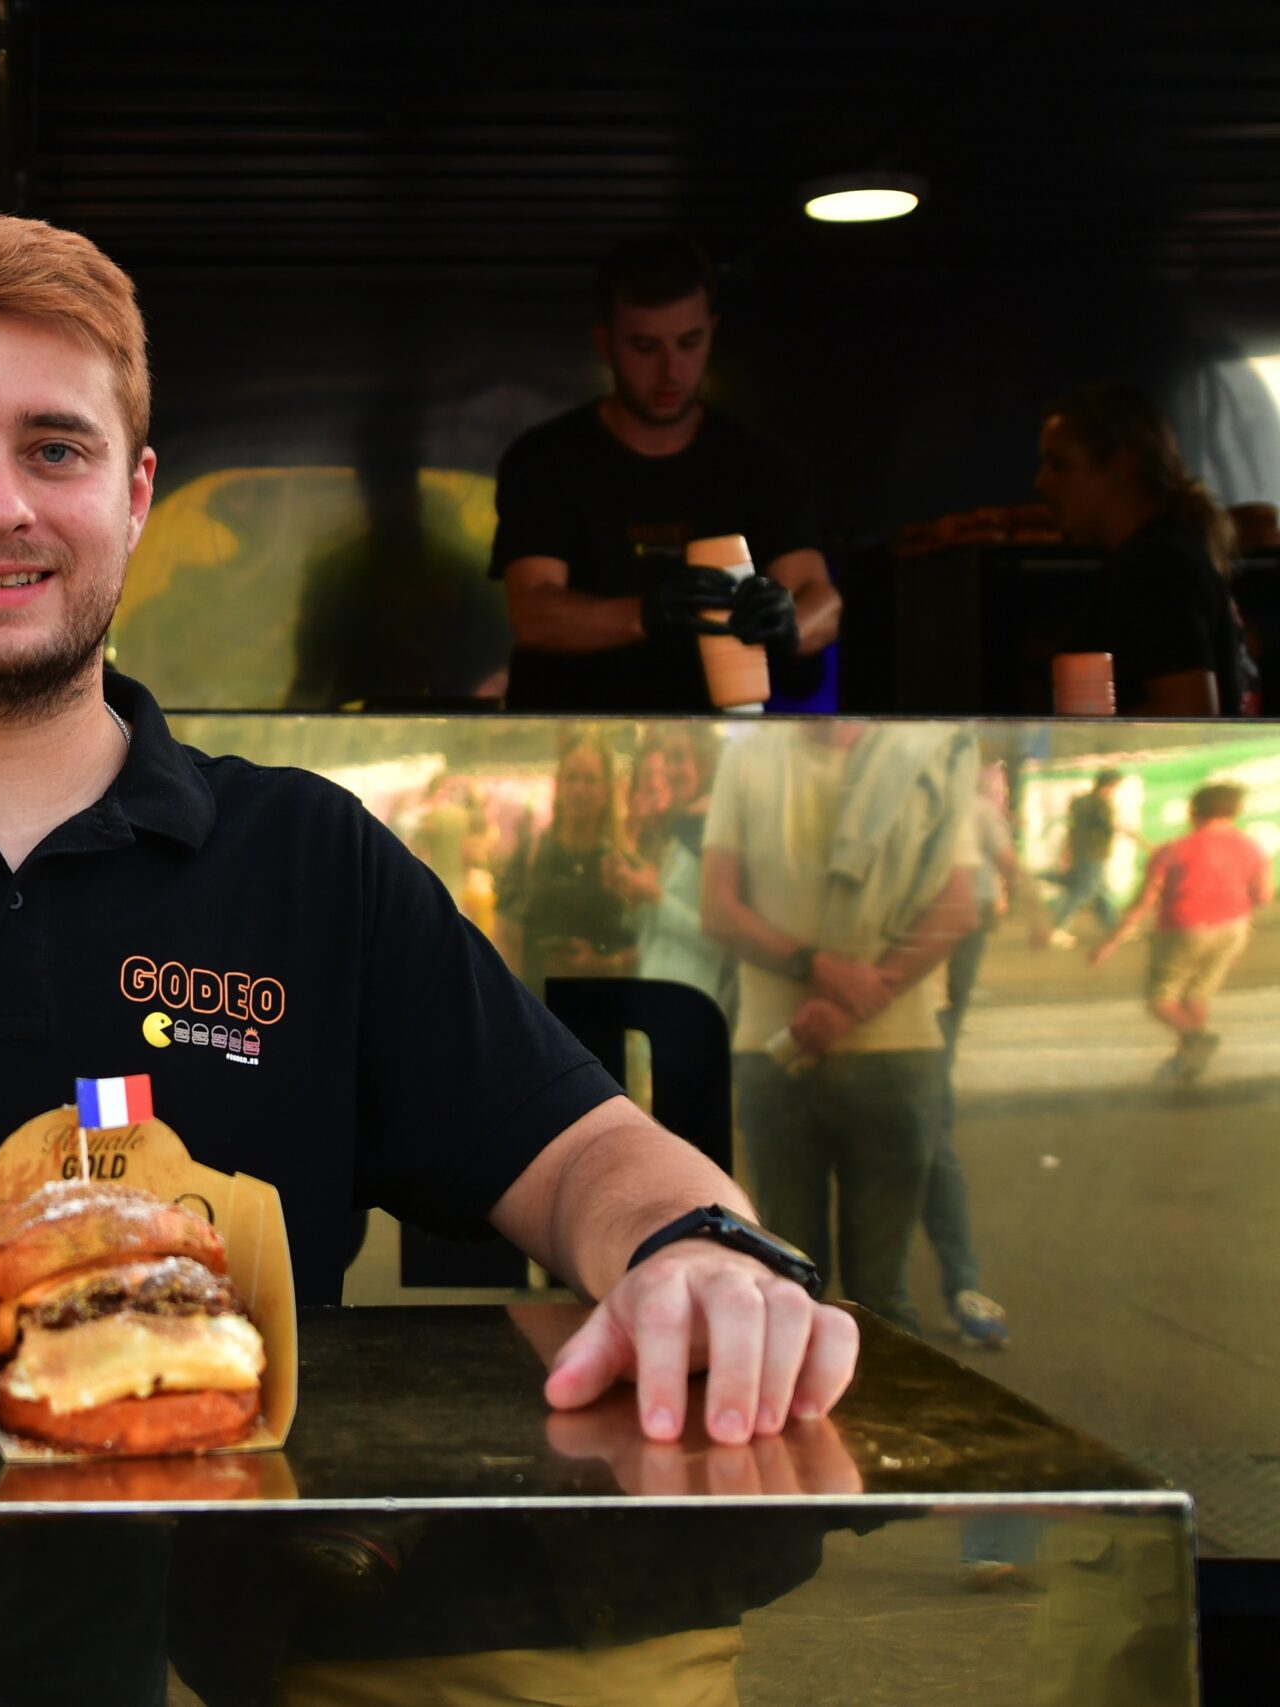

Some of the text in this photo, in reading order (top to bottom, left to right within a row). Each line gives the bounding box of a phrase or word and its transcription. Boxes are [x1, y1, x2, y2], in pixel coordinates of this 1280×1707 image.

[120, 955, 285, 1025] GODEO
[42, 1123, 145, 1155] Ryale
[62, 1153, 127, 1180] GOLD
